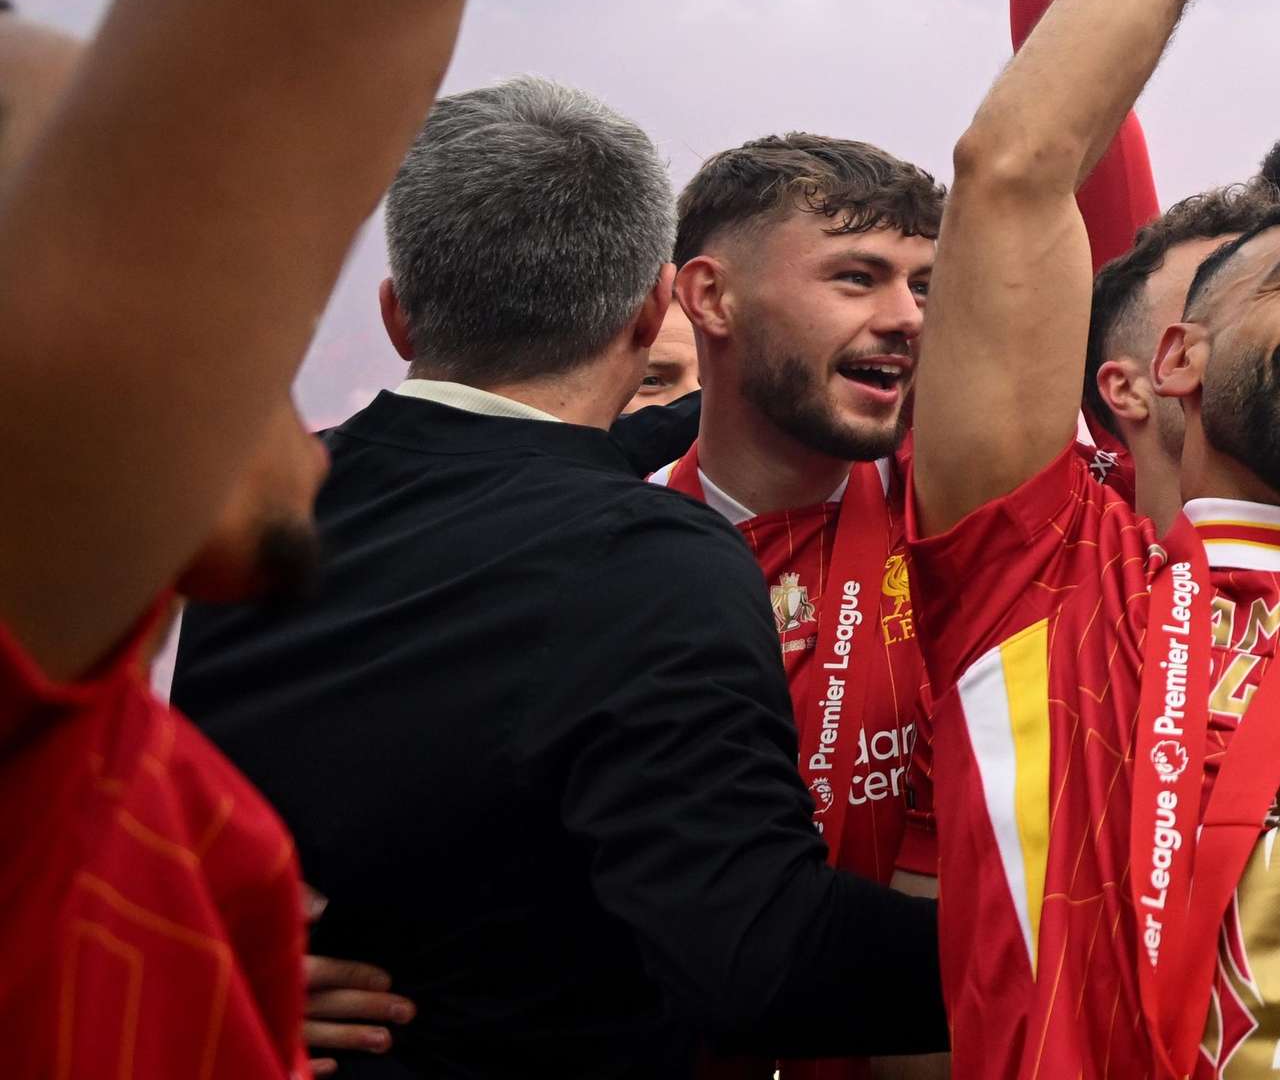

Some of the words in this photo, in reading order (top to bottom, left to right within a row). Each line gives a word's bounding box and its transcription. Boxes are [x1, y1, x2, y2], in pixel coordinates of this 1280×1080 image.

[823, 580, 863, 670] League
[1162, 561, 1200, 636] League
[808, 675, 847, 771] Premier
[1153, 638, 1189, 736] Premier
[1140, 790, 1183, 910] League
